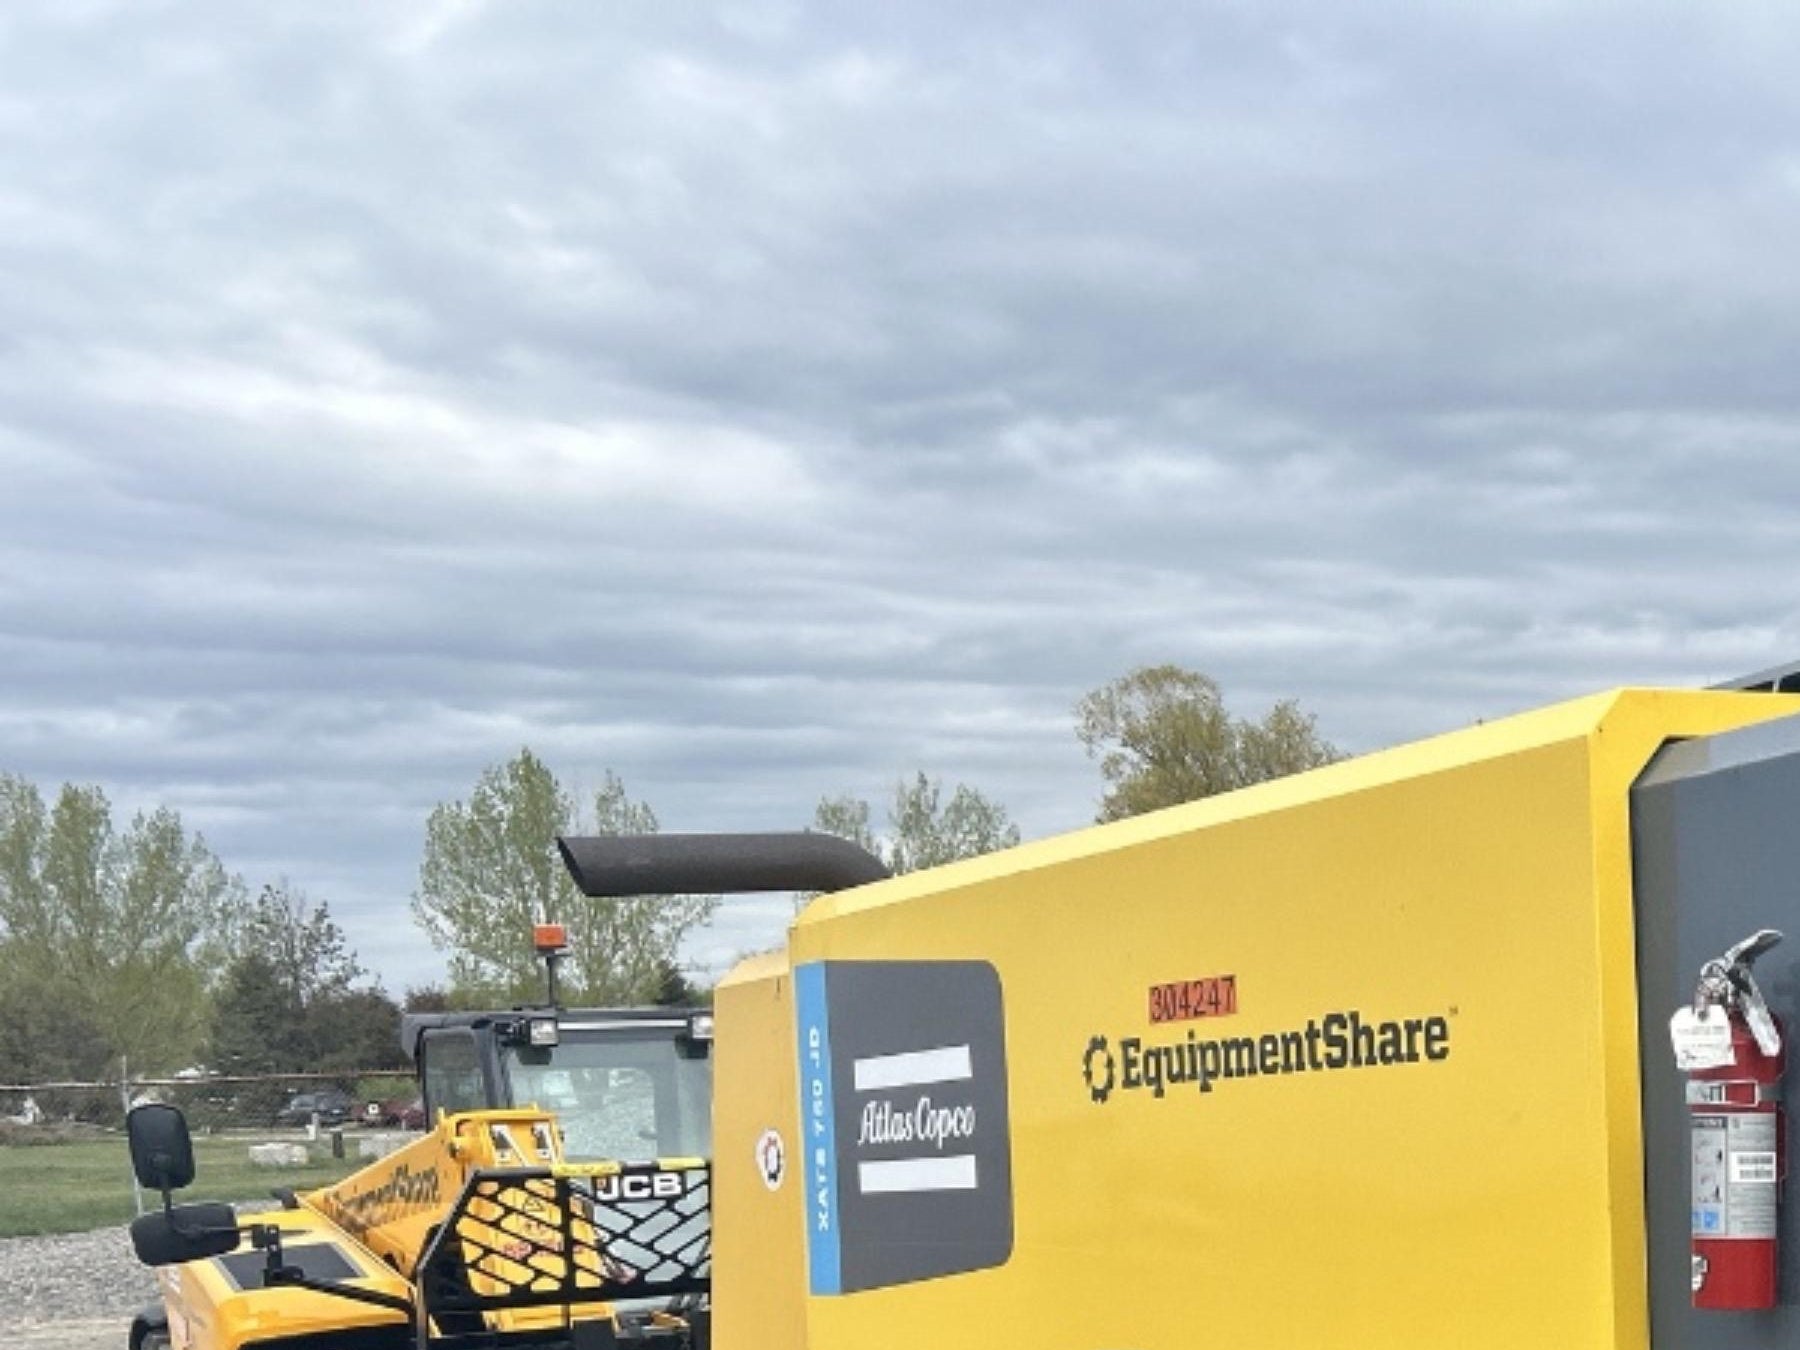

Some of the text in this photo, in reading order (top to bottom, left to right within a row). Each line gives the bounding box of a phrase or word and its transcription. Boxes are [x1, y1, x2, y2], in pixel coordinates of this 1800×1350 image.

[1150, 975, 1236, 1023] 304247
[1120, 1011, 1449, 1098] EquipmentShare
[857, 1096, 977, 1149] Atlas Copco
[596, 1172, 684, 1201] JCB
